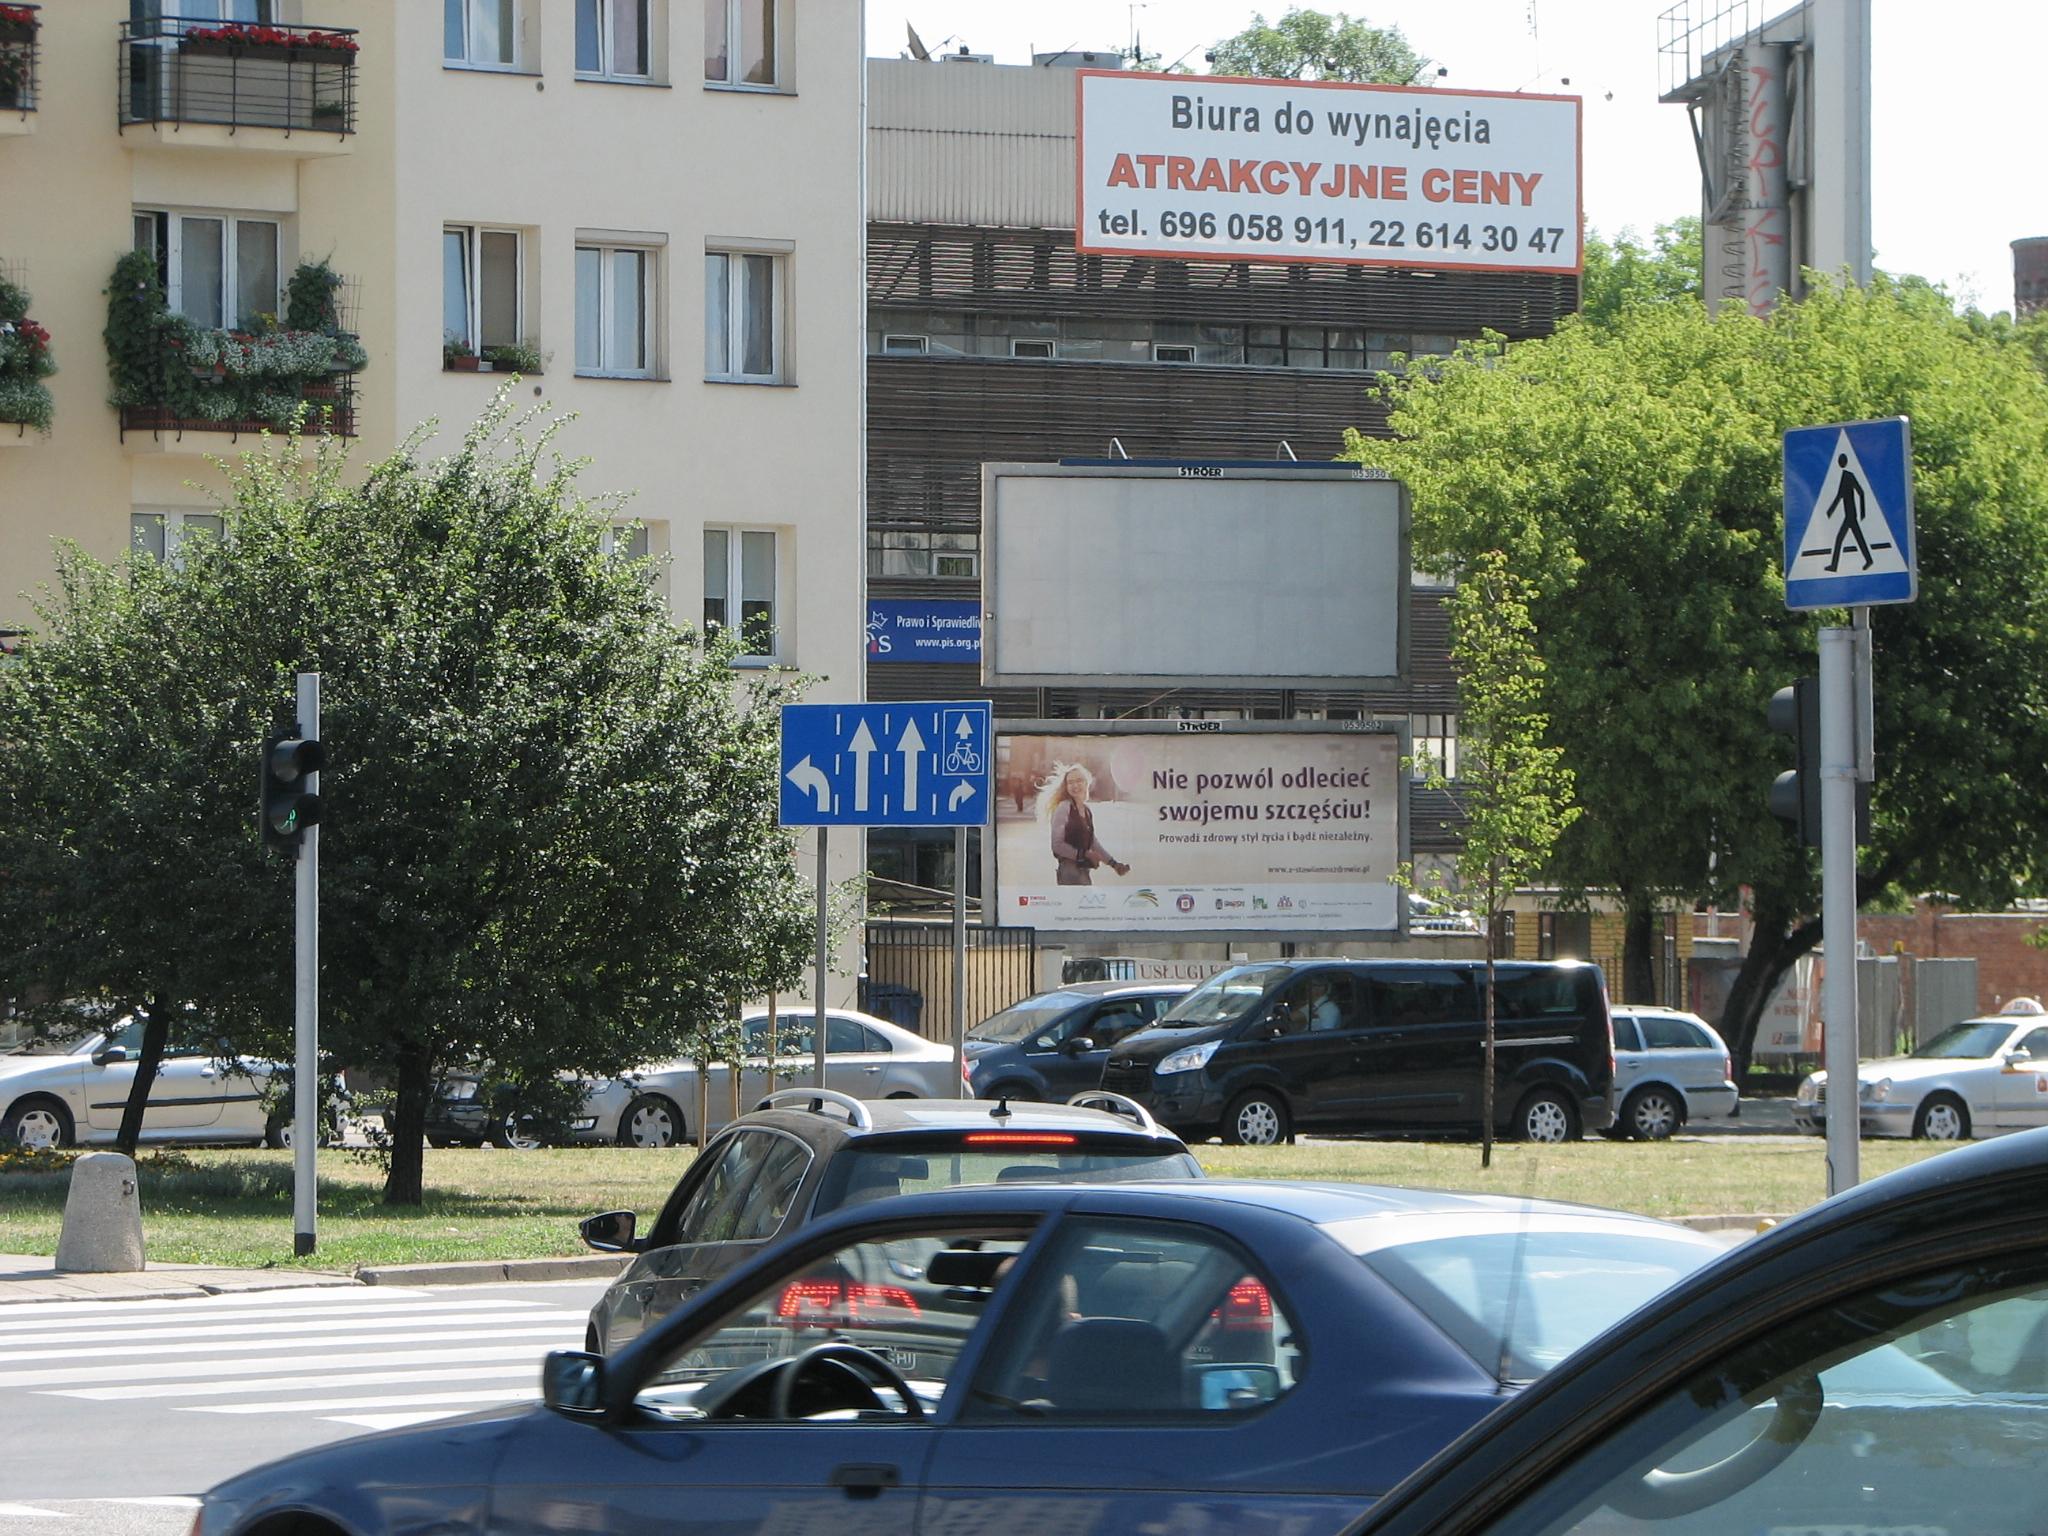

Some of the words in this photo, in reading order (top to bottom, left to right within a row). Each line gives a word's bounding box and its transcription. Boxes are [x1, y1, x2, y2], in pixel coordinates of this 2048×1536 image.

[1171, 95, 1261, 132] Biura
[1275, 101, 1314, 136] do
[1327, 107, 1492, 150] wynajęcia
[1107, 153, 1408, 200] ATRAKCYJNE
[1421, 168, 1544, 206] CENY
[1098, 208, 1148, 236] tel.
[1159, 211, 1217, 238] 696
[1227, 213, 1283, 242] 058
[1294, 216, 1357, 250] 911,
[1368, 220, 1406, 247] 22
[1415, 222, 1472, 250] 614
[1482, 225, 1519, 252] 30
[1528, 227, 1565, 254] 47
[896, 615, 924, 628] Prawo
[926, 615, 930, 628] i
[1153, 769, 1188, 790] Nie
[1196, 768, 1273, 794] pozwól
[1282, 767, 1371, 789] odlecieć
[1159, 801, 1259, 825] swojemu
[1265, 799, 1371, 824] szczęściu!
[1203, 832, 1239, 845] zdrowy
[1241, 832, 1260, 844] styl
[1139, 964, 1204, 980] USŁUGI
